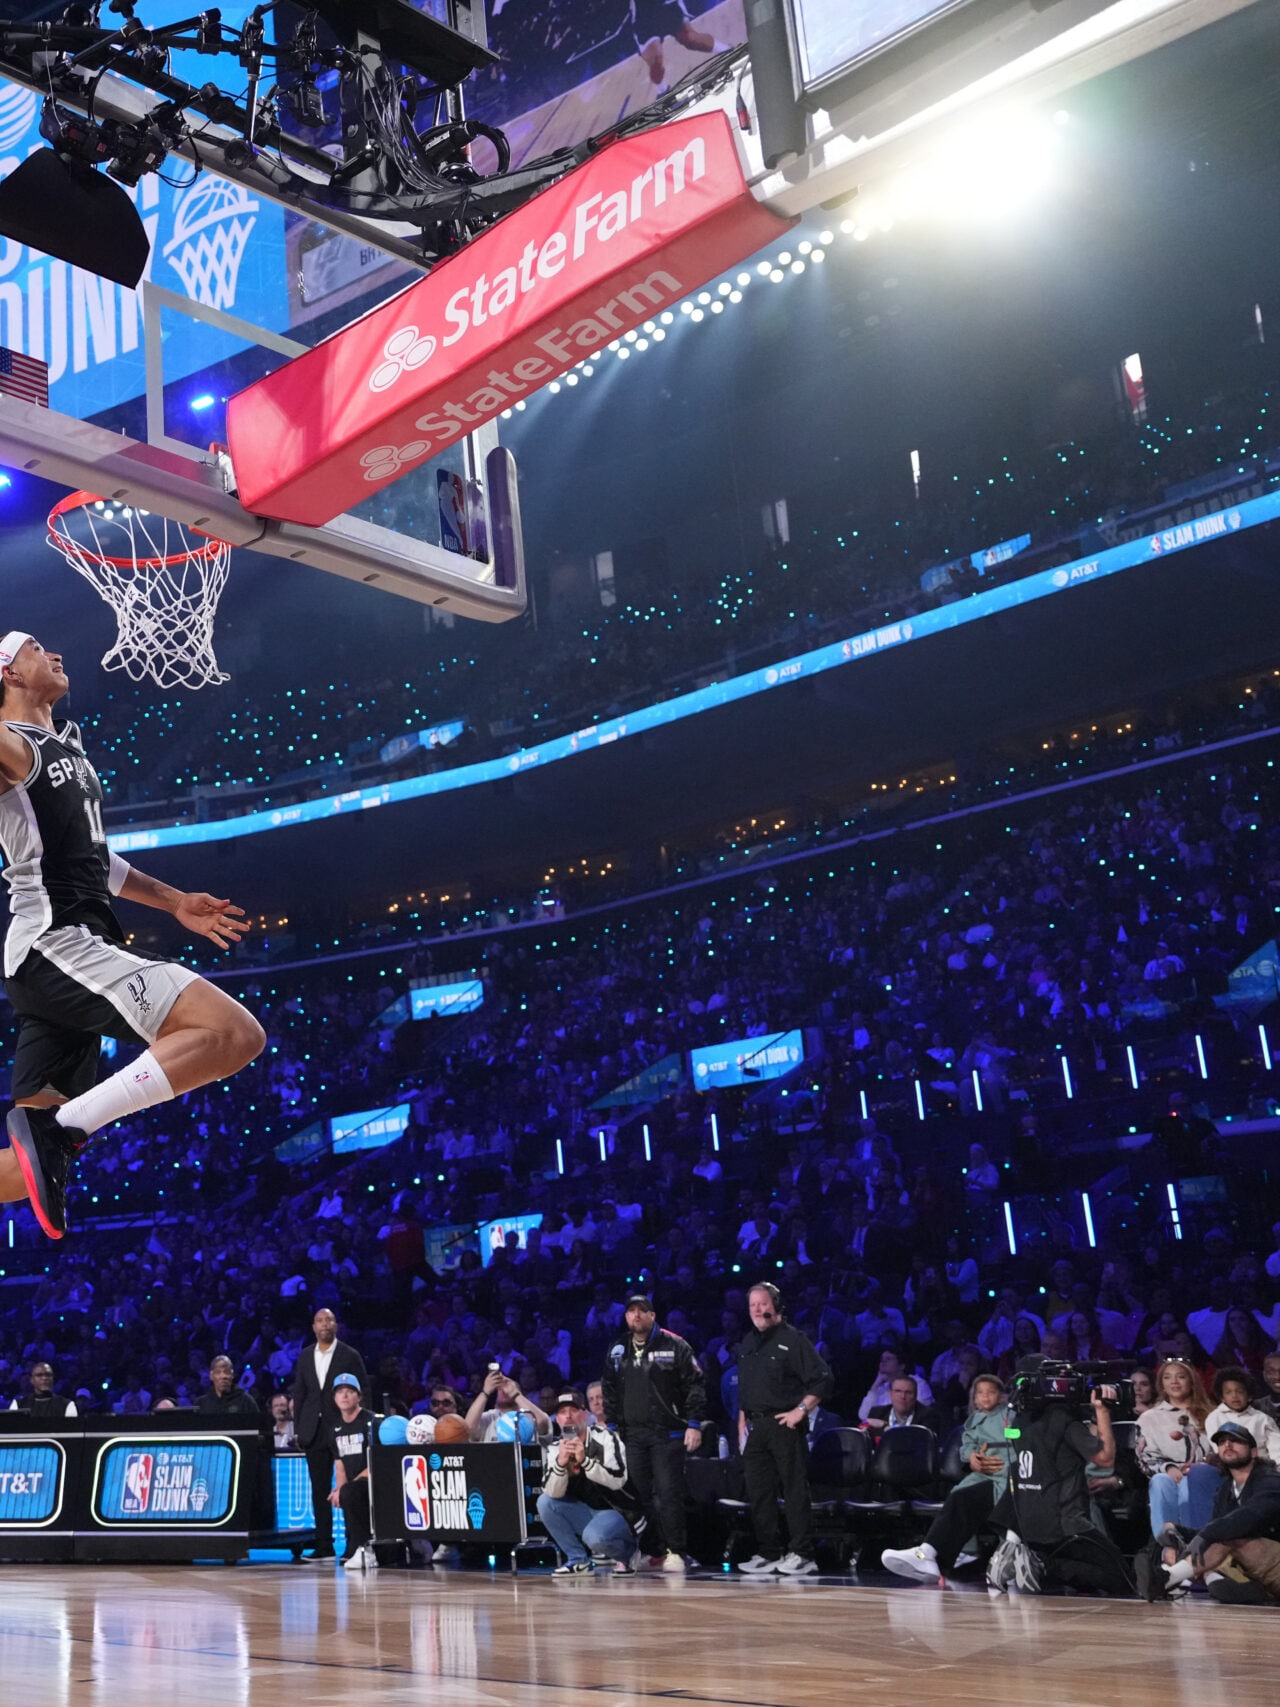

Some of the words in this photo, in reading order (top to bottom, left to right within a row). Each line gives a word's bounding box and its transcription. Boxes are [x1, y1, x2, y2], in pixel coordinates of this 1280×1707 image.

[1163, 525, 1195, 551] SLAM
[1195, 514, 1228, 539] DUNK
[1070, 561, 1100, 580] AT&T
[852, 634, 876, 656] SLAM
[877, 625, 902, 647] DUNK
[779, 662, 803, 678] AT&T
[47, 757, 99, 792] SPUR
[84, 798, 107, 844] 11
[171, 1454, 194, 1463] AT&T
[442, 1456, 464, 1467] AT&T
[154, 1466, 193, 1488] SLAM
[430, 1470, 467, 1500] SLAM
[151, 1489, 190, 1512] DUNK
[432, 1500, 469, 1529] DUNK
